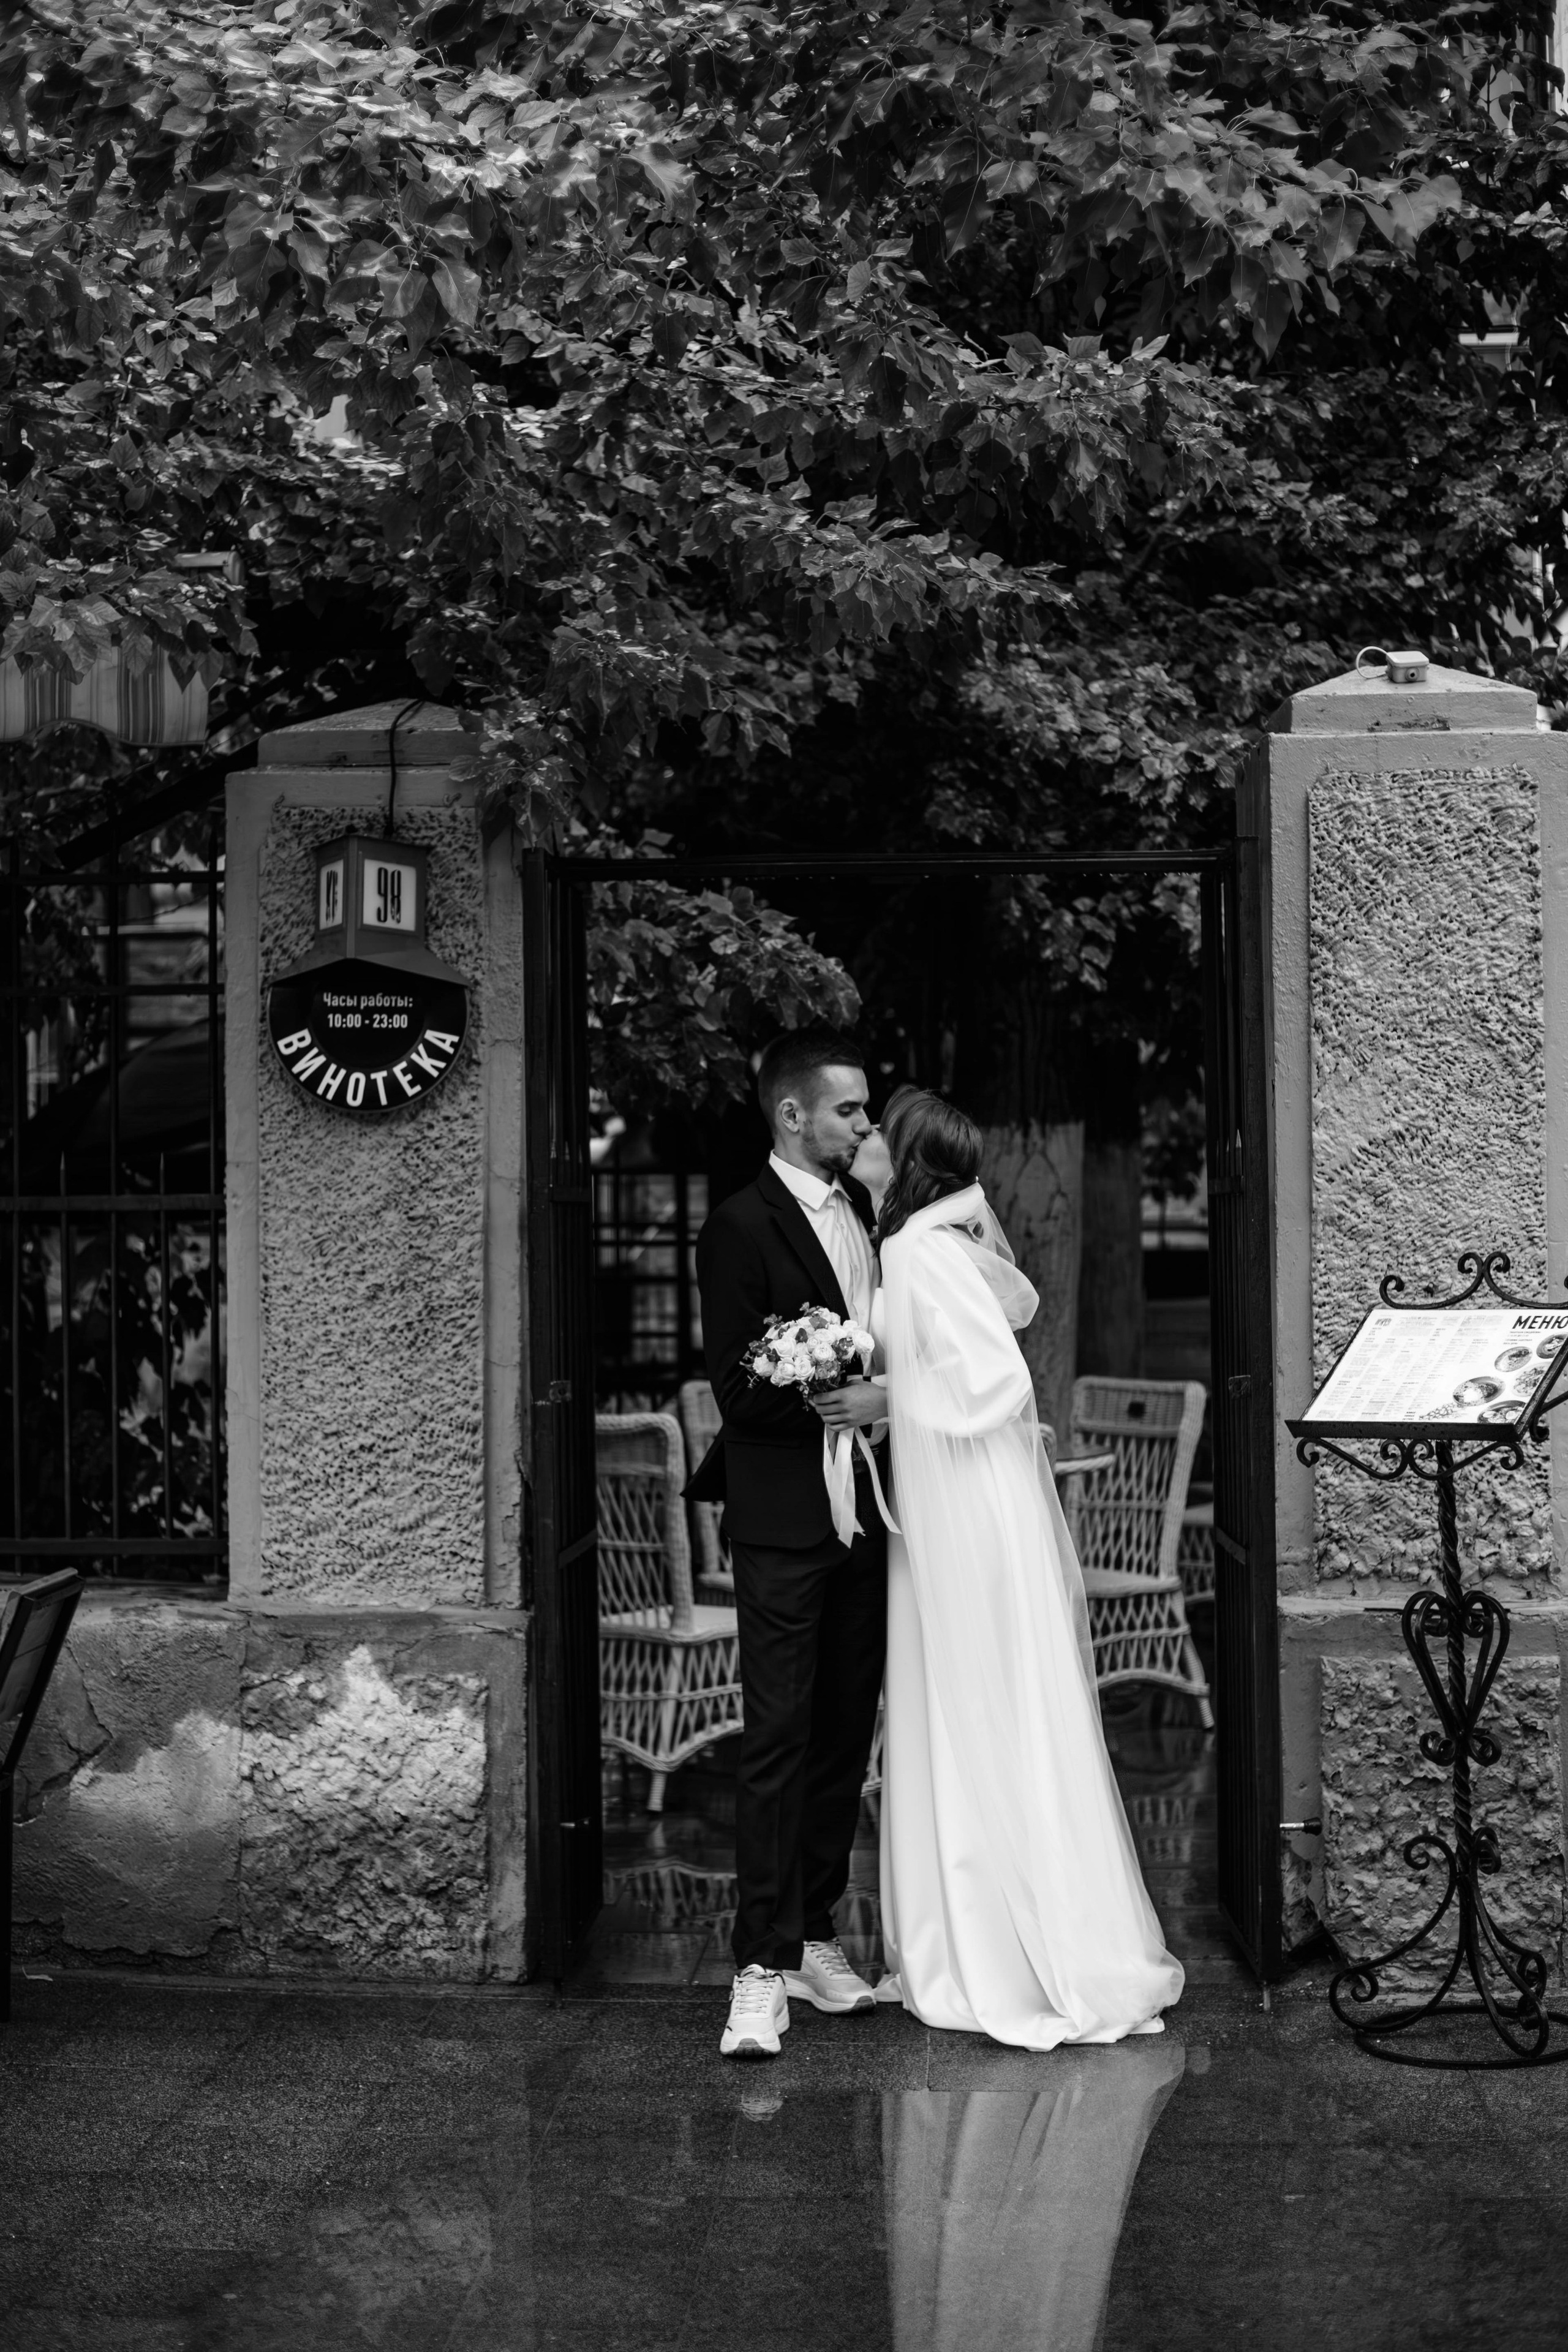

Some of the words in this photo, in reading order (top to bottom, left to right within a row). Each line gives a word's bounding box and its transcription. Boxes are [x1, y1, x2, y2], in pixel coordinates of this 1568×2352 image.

[323, 992, 358, 1007] Часы
[360, 992, 413, 1010] работы:
[327, 1013, 362, 1028] 10:00
[372, 1013, 409, 1028] 23:00
[277, 1028, 460, 1107] ВИНОТЕКА
[1512, 1315, 1568, 1329] МЕНЮ
